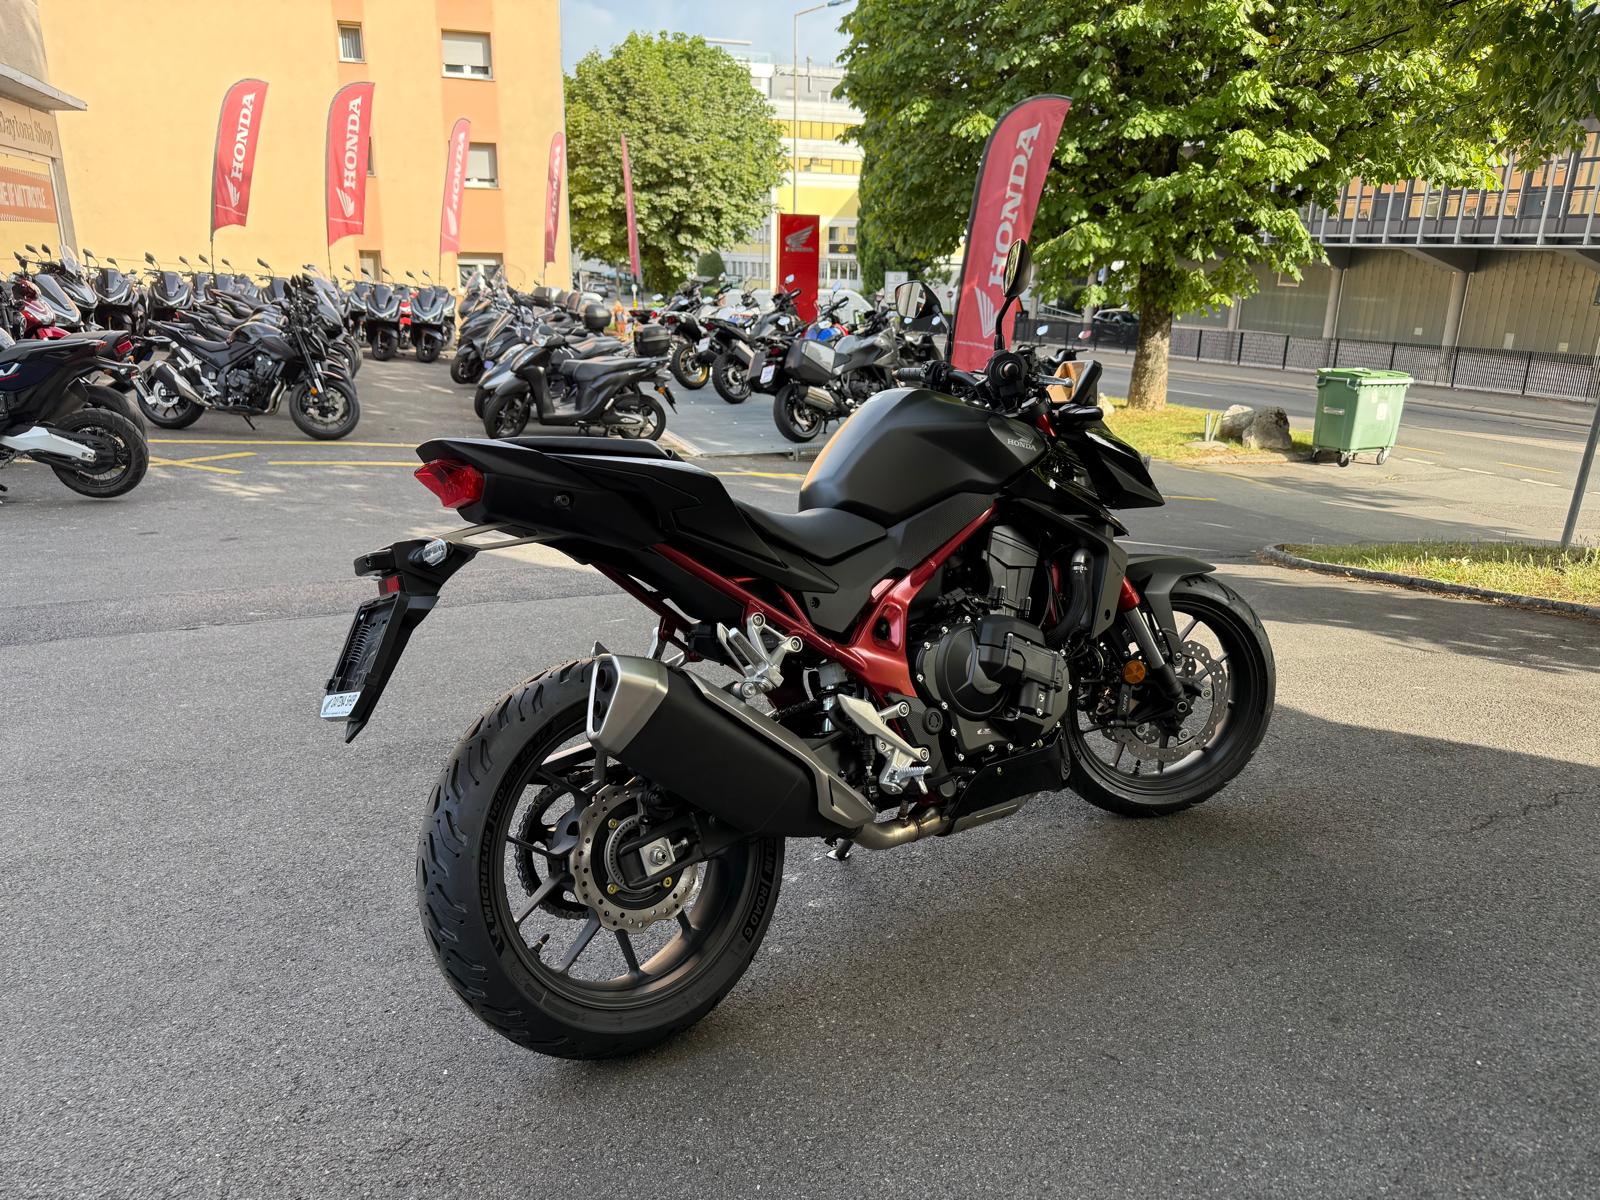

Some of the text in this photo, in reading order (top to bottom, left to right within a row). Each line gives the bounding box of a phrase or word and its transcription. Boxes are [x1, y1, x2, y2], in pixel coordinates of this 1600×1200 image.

[231, 92, 256, 182] HONDA
[343, 95, 362, 190] HONDA
[988, 121, 1042, 288] HONDA
[1007, 438, 1037, 452] HONDA
[480, 825, 496, 922] MICHELIN
[750, 886, 769, 926] ROAD
